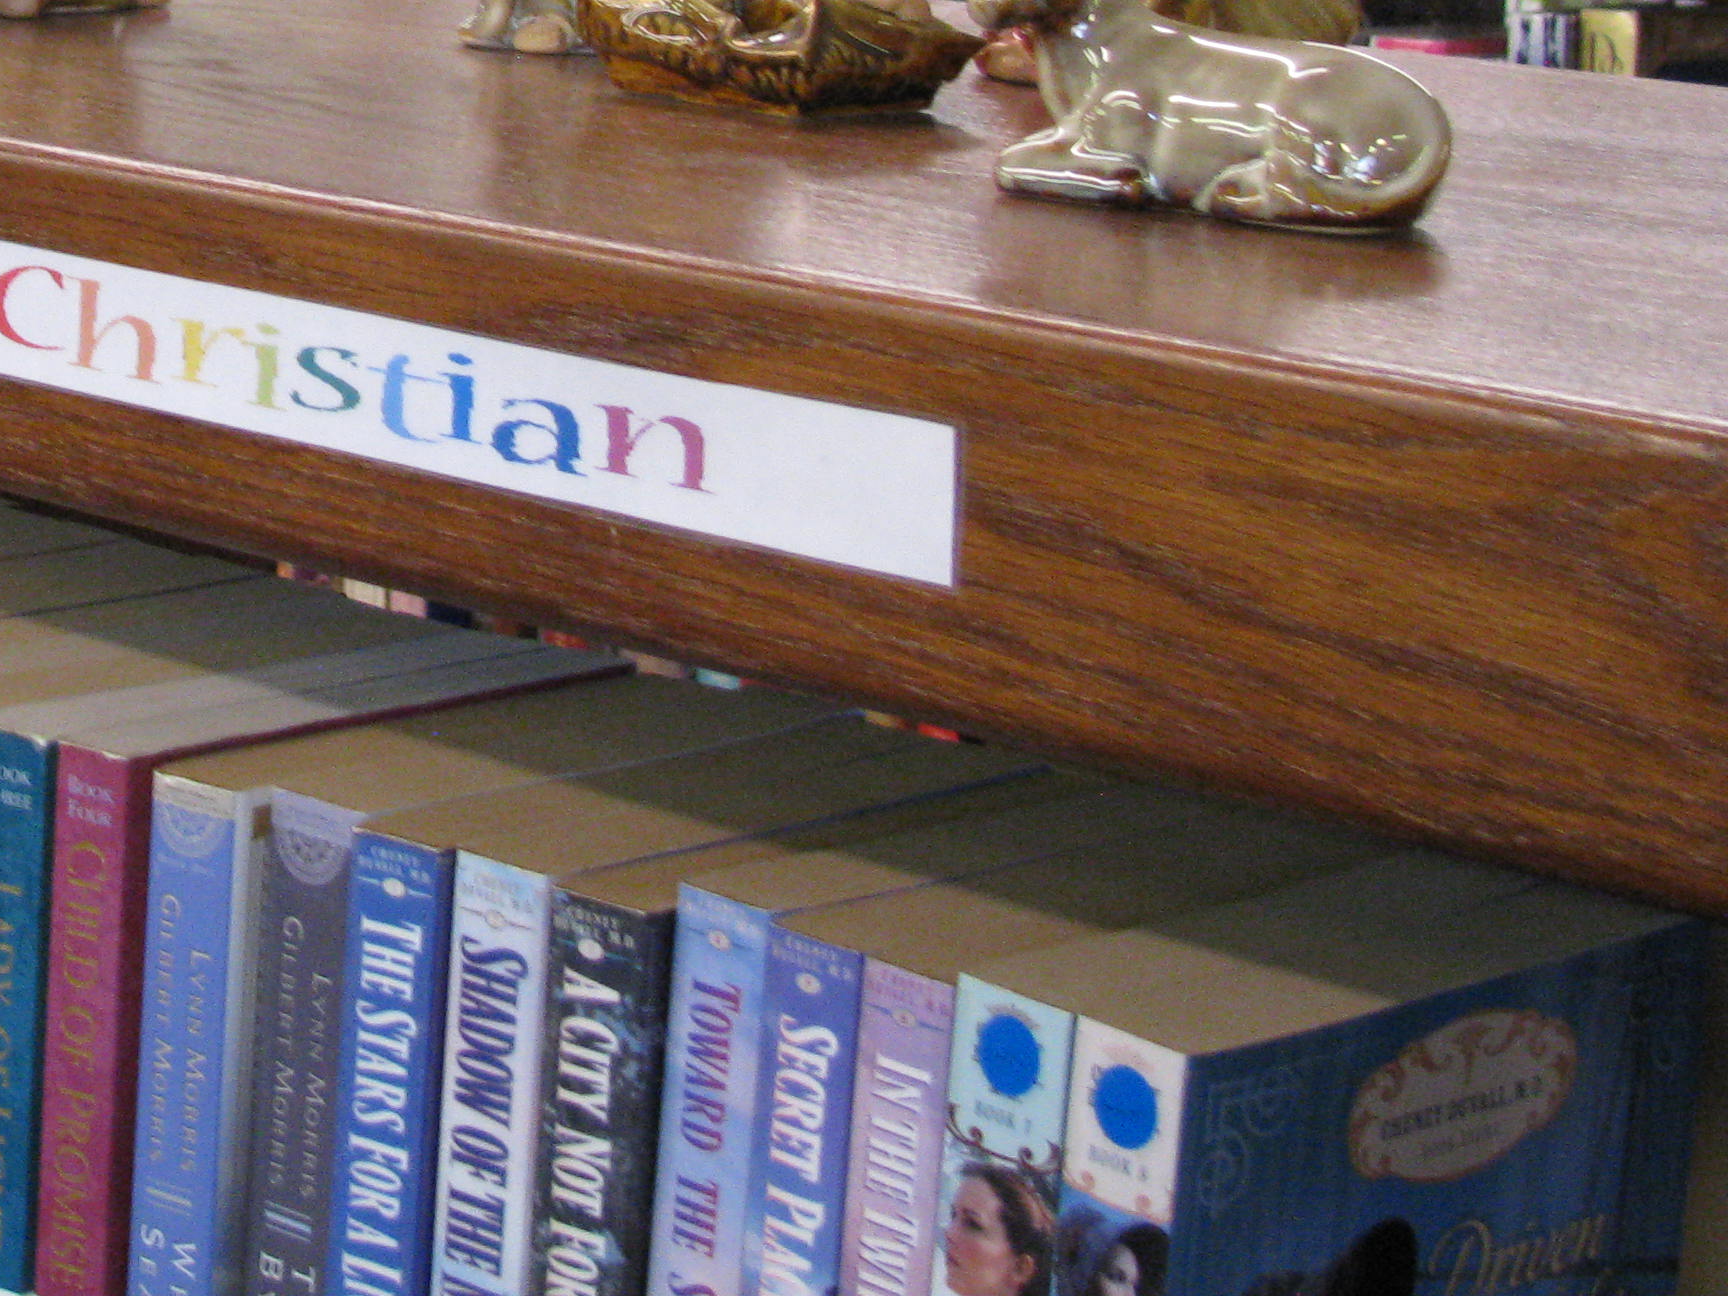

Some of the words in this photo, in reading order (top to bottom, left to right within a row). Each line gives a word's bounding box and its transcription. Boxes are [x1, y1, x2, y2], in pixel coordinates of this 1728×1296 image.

[62, 841, 106, 990] CHILD
[156, 893, 181, 1026] GILBERT
[360, 914, 423, 1002] THE
[185, 949, 212, 1034] LYNN
[277, 915, 305, 1053] GILBERT
[308, 972, 333, 1061] LYNN
[454, 935, 528, 1124] SHADOW
[561, 966, 621, 1006] A
[58, 1006, 94, 1074] OF
[351, 1000, 418, 1134] STARS
[555, 1014, 620, 1122] CITY
[680, 977, 743, 1154] TOWARD
[869, 1052, 936, 1115] IN
[149, 1037, 176, 1163] MORRIS
[179, 1047, 208, 1172] MORRIS
[269, 1060, 296, 1186] MORRIS
[300, 1073, 327, 1200] MORRIS
[770, 1013, 839, 1182] SECRET
[49, 1087, 94, 1292] PROMISE
[348, 1132, 410, 1220] FOR
[451, 1124, 509, 1188] OF
[551, 1122, 612, 1219] NOT
[863, 1114, 922, 1206] THE
[346, 1214, 401, 1249] A
[444, 1180, 506, 1280] THE
[672, 1174, 721, 1259] THE
[1427, 1213, 1606, 1296] Driven
